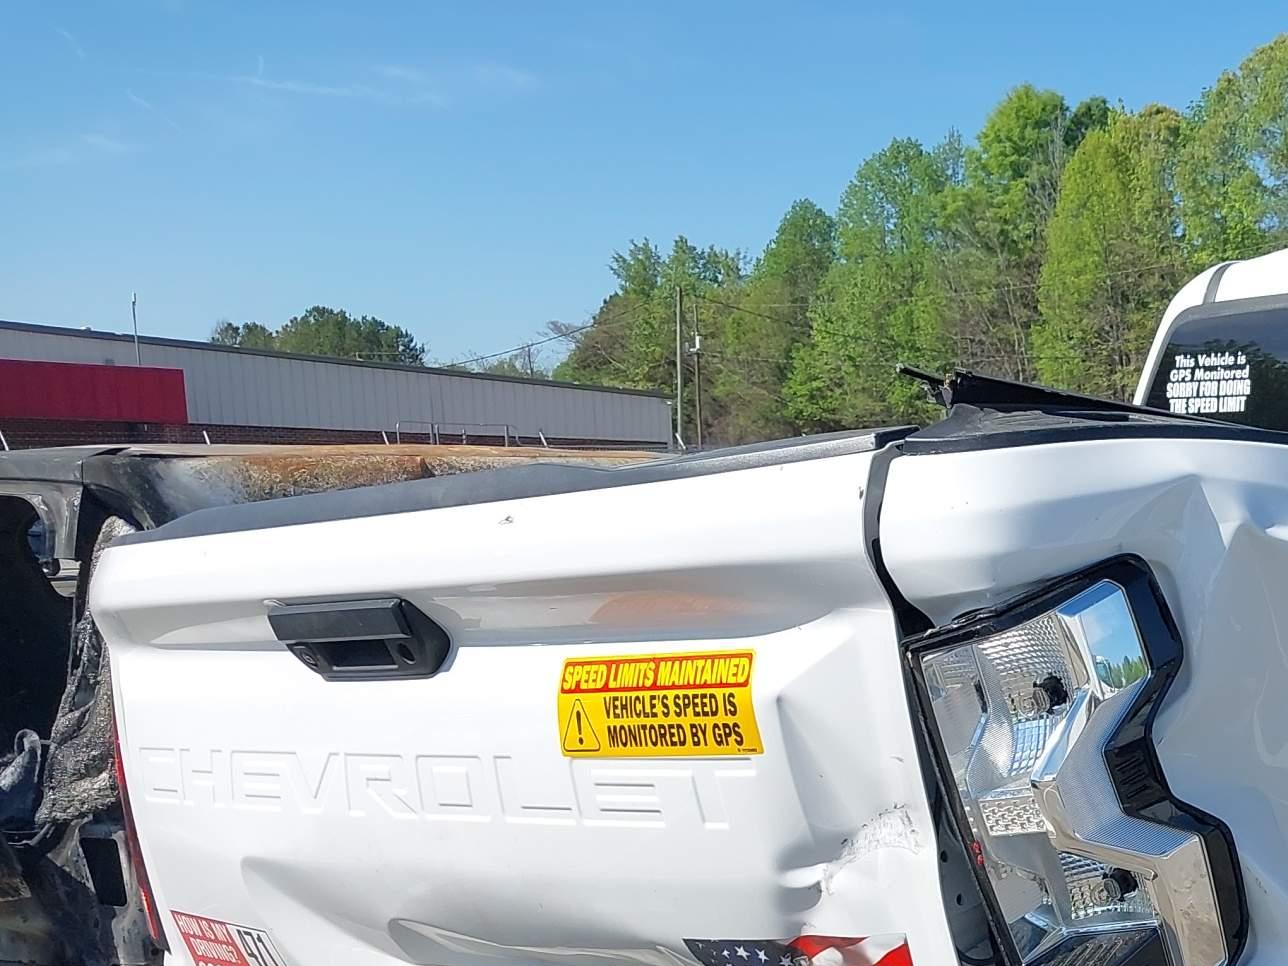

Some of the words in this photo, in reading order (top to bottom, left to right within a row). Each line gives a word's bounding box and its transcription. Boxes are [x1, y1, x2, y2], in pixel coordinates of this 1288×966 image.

[1169, 369, 1192, 382] GPS
[1193, 364, 1250, 381] Monitored
[1174, 354, 1195, 368] This
[1197, 351, 1235, 367] Vehicle
[1236, 351, 1247, 365] is
[1166, 382, 1199, 398] SORRY
[1199, 380, 1218, 397] FOR
[1218, 379, 1251, 396] DOING
[1168, 398, 1187, 414] THE
[1187, 397, 1218, 414] SPEED
[1218, 396, 1247, 413] LIMIT
[562, 663, 608, 691] SPEED
[608, 660, 656, 689] LIMITS
[656, 656, 751, 688] MAINTAINED
[603, 693, 671, 719] VEHICLE'S
[673, 692, 719, 718] SPEED
[722, 692, 738, 717] IS
[606, 723, 687, 748] MONITORED
[690, 723, 709, 747] BY
[711, 721, 744, 747] GPS
[138, 747, 758, 830] CHEVROLET
[174, 913, 202, 937] HOW
[198, 919, 216, 940] IS
[209, 921, 233, 944] MY
[189, 936, 241, 963] DRIVING?
